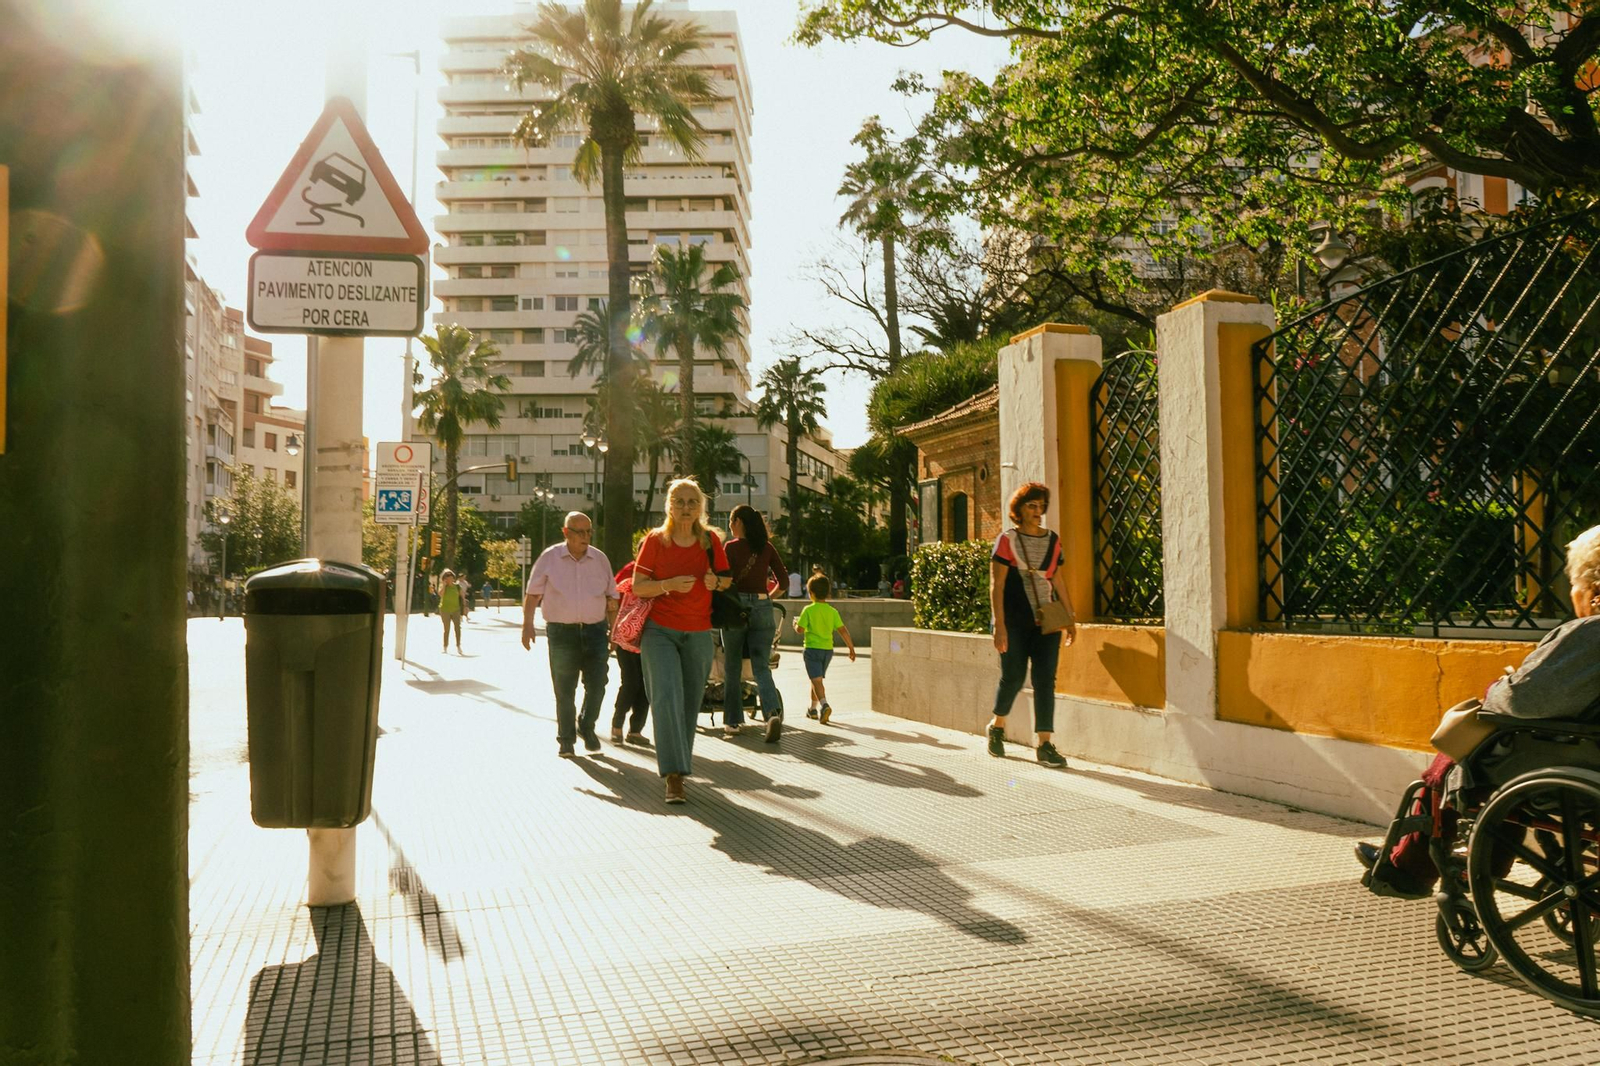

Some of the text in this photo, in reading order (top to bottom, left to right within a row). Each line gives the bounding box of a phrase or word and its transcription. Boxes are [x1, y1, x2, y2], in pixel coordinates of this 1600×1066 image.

[307, 260, 373, 277] ATENCION
[258, 281, 417, 303] PAVIMENTO DESLIZANTE
[302, 308, 370, 327] POR CERA
